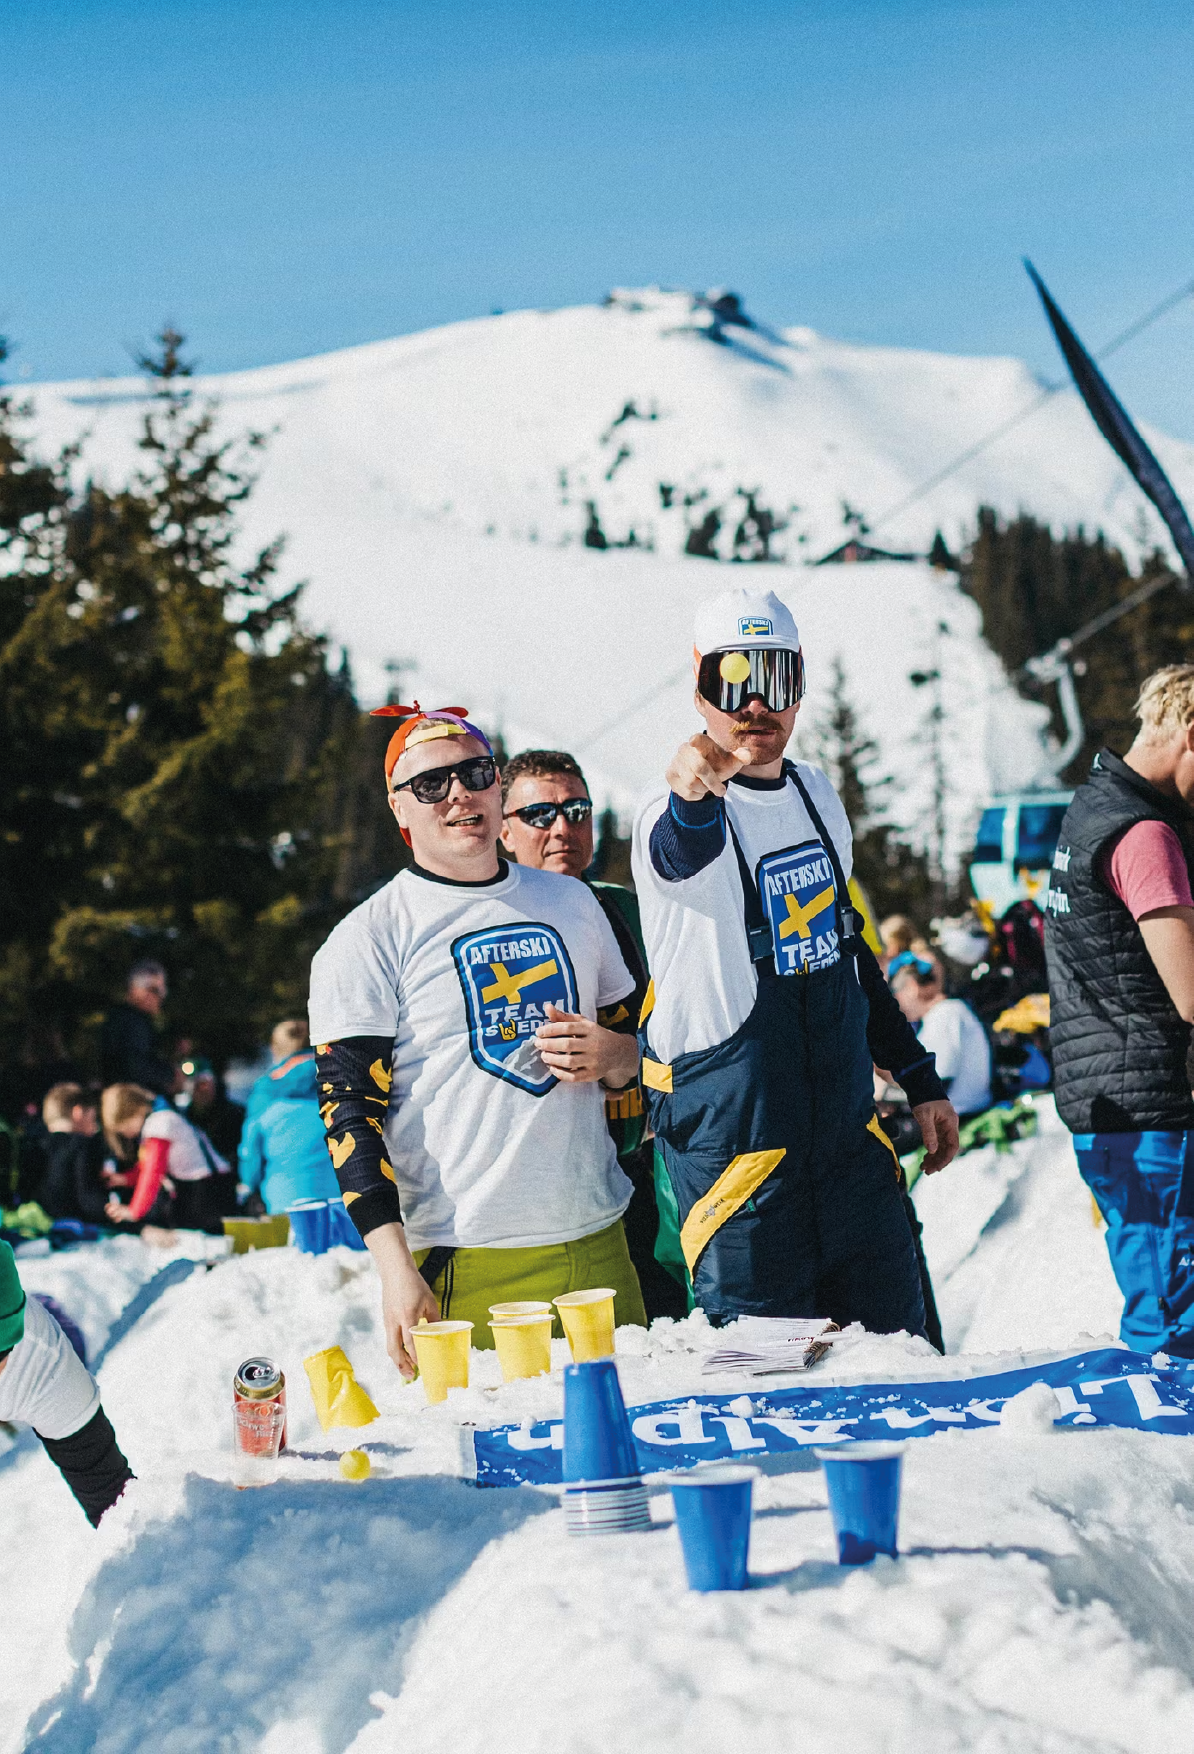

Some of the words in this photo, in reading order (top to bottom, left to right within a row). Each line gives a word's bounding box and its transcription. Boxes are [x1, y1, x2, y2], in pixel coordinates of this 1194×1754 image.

[766, 857, 831, 896] AFTERSKI
[470, 936, 551, 965] AFTERSKI
[493, 1407, 860, 1451] Alpn
